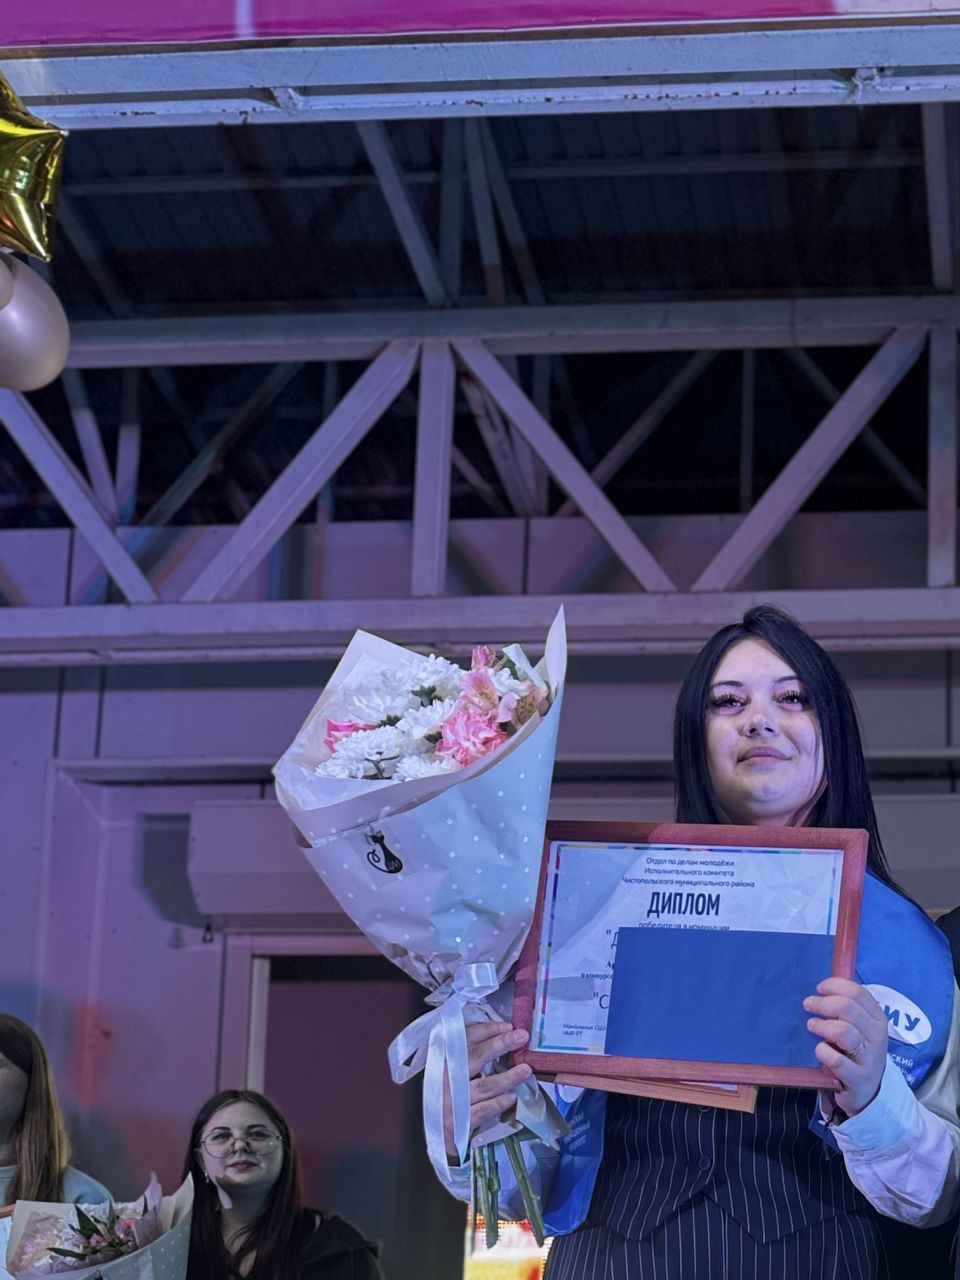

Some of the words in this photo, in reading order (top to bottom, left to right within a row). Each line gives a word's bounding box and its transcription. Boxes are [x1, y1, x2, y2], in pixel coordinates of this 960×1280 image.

[646, 857, 667, 866] Отдел
[644, 868, 702, 876] Исполнительного
[646, 891, 721, 918] ДИПЛОМ
[883, 1004, 921, 1032] ИУ
